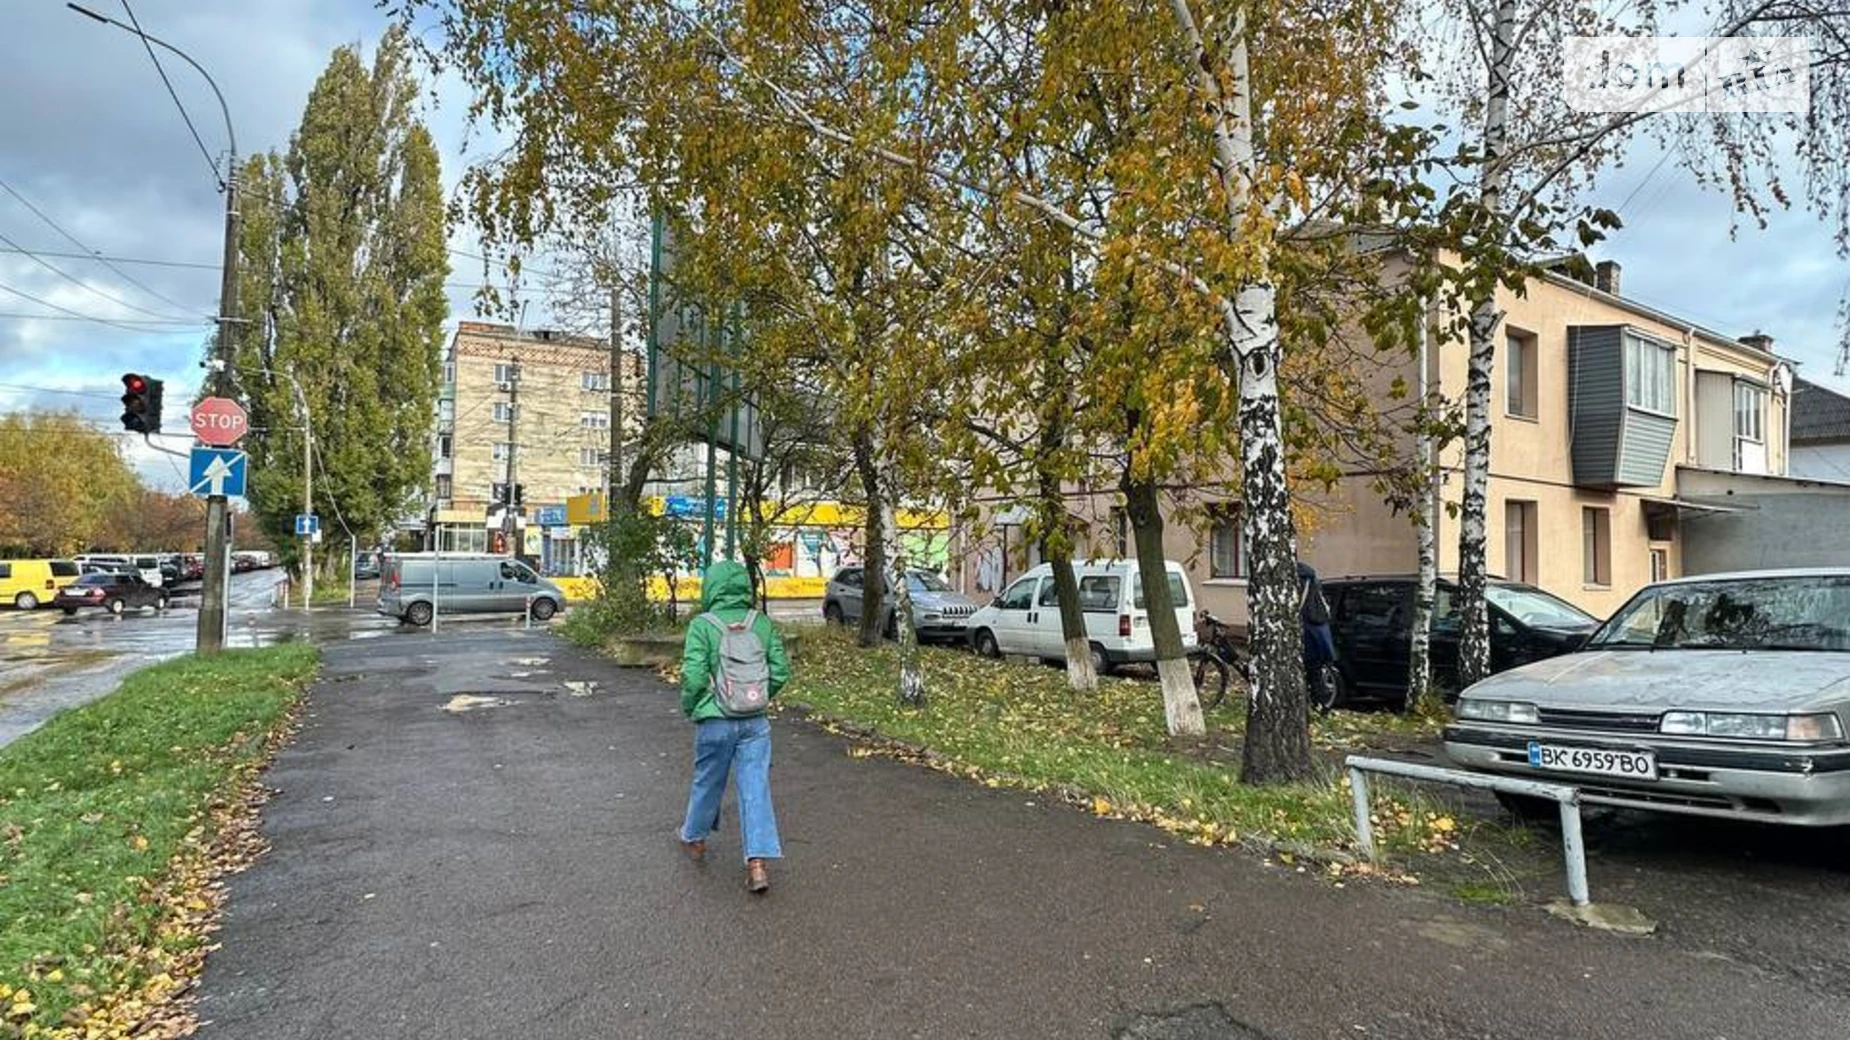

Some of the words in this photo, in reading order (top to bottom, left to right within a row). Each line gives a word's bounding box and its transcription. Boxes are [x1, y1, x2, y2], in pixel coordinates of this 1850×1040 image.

[195, 412, 244, 429] STOP
[1542, 748, 1568, 767] BK
[1571, 750, 1616, 771] 6959
